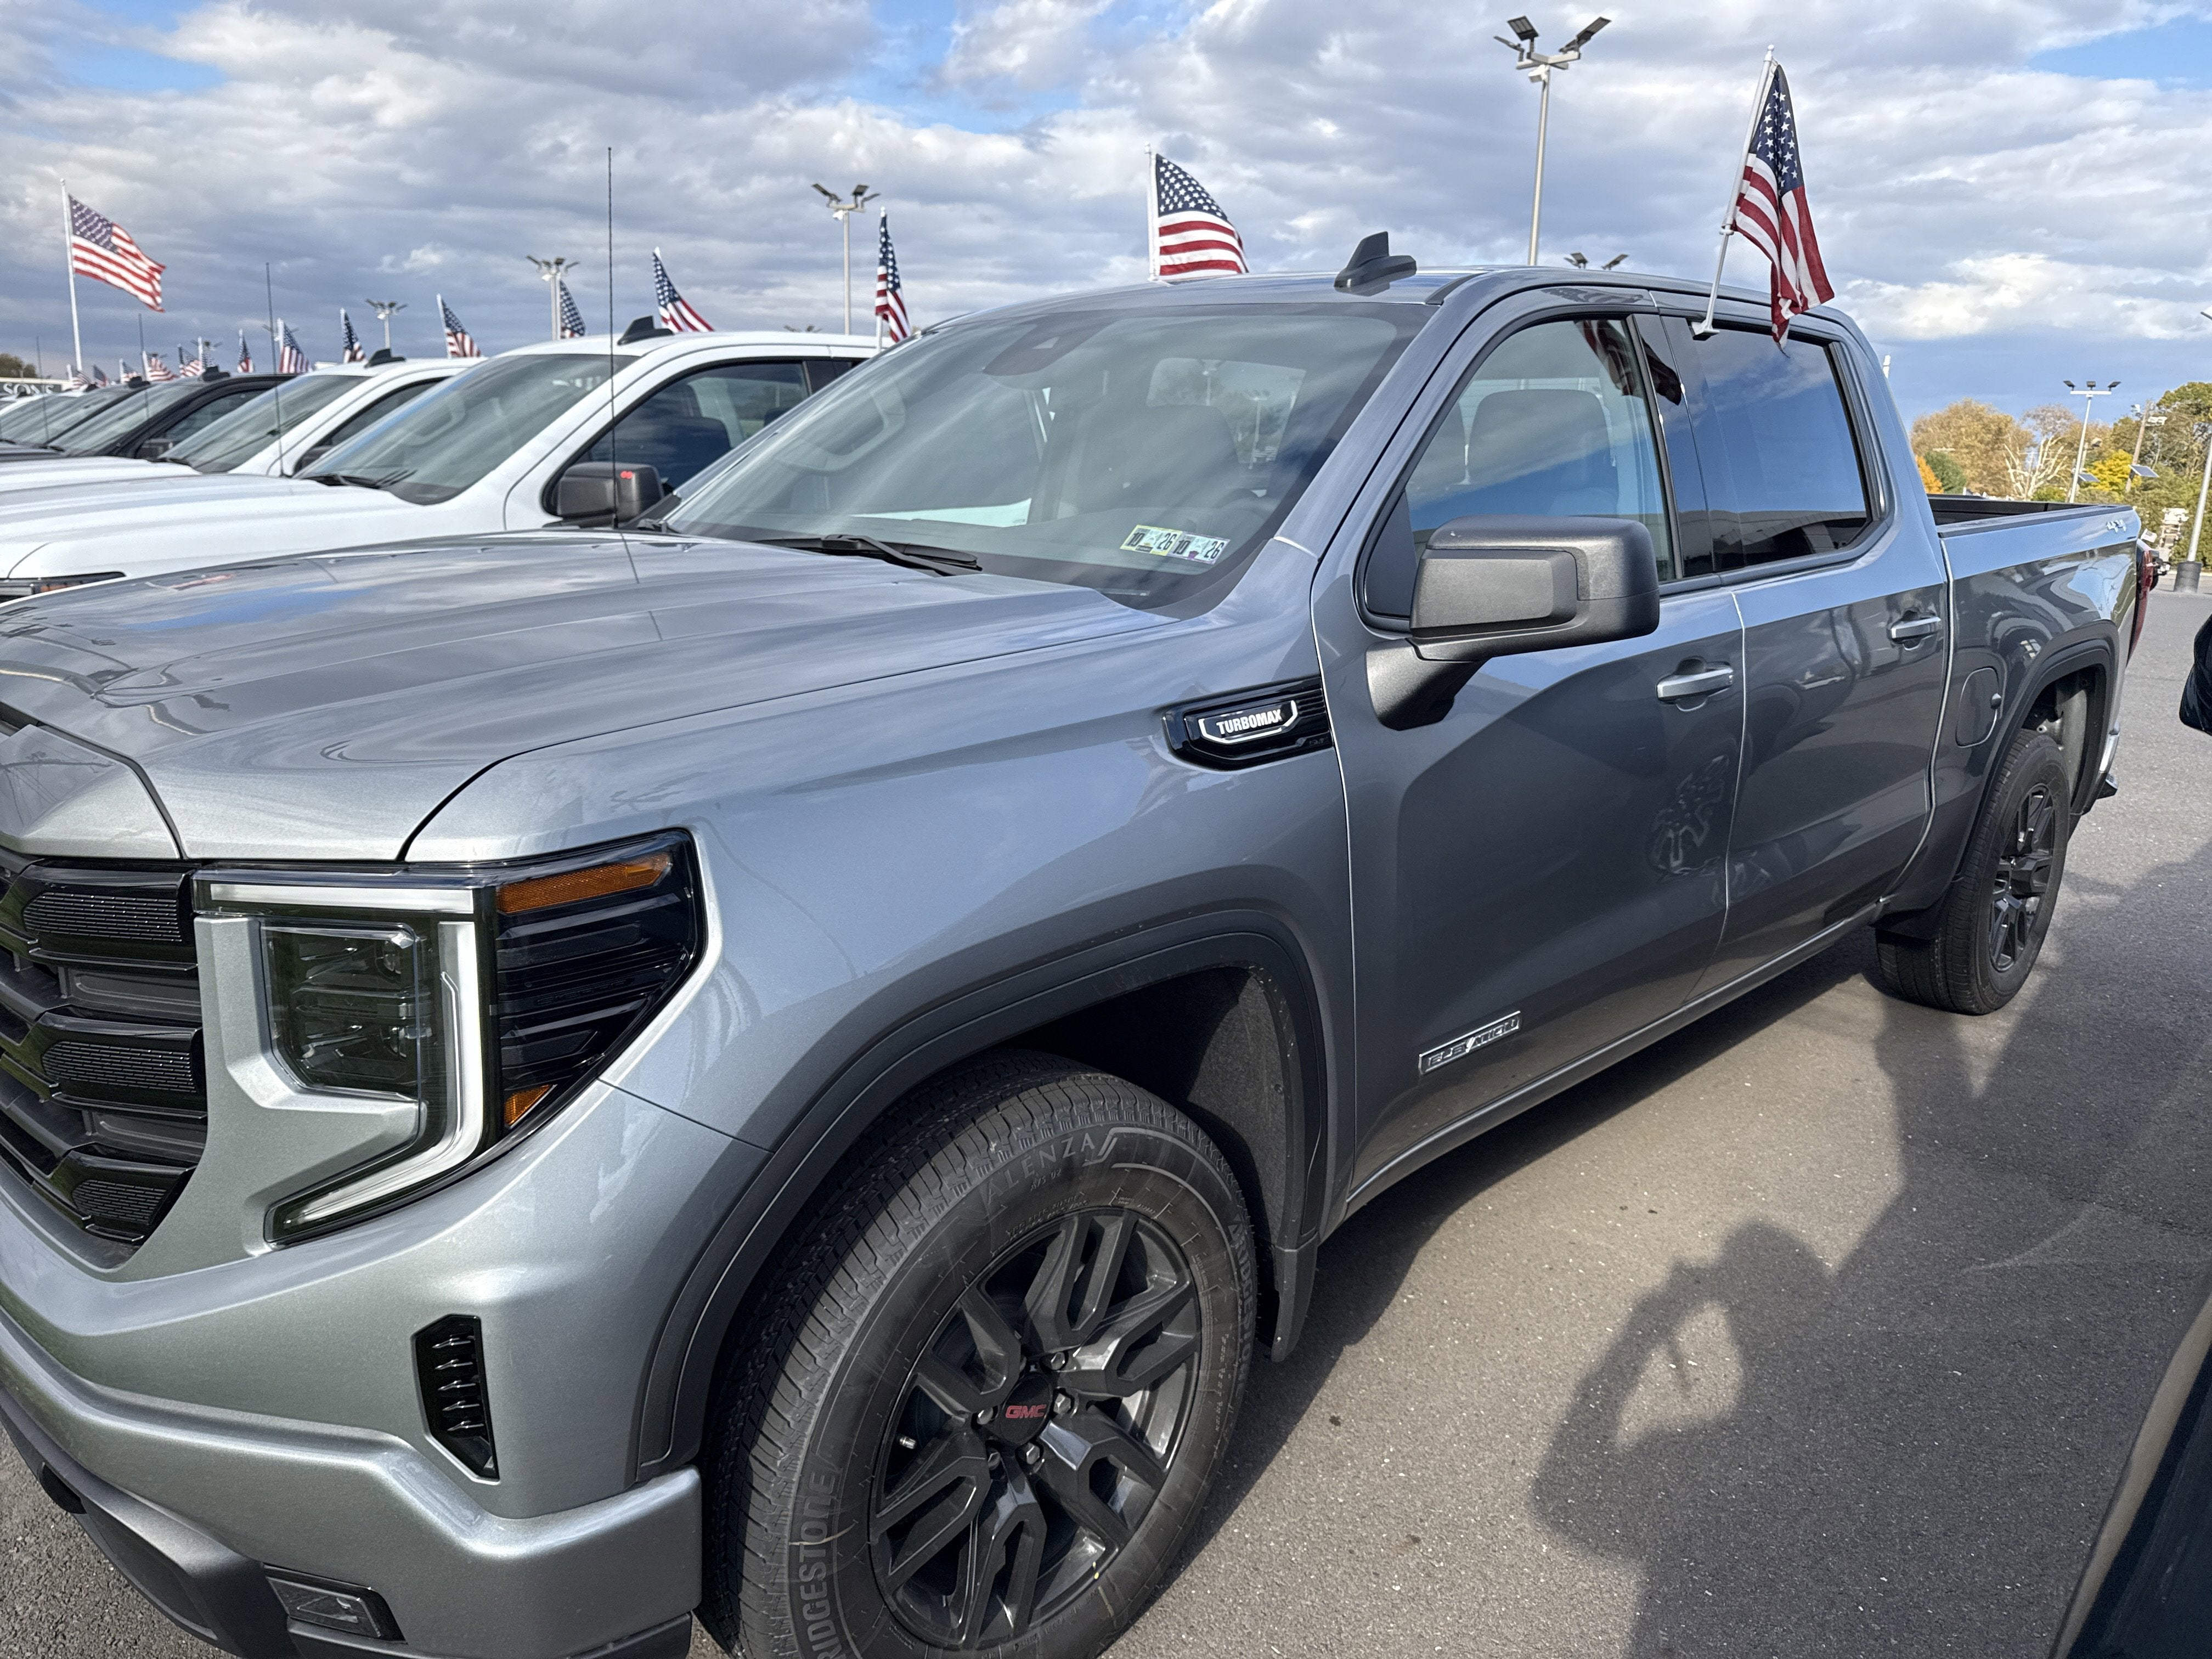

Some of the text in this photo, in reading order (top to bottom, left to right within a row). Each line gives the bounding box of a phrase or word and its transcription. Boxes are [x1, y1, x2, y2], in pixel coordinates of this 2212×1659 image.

[1127, 532, 1144, 546] 10
[1158, 533, 1177, 550] 26
[1173, 540, 1224, 558] 10 26
[1216, 709, 1282, 734] TURBOMAX
[987, 1132, 1096, 1206] ALENZA
[1005, 1404, 1047, 1419] GMC
